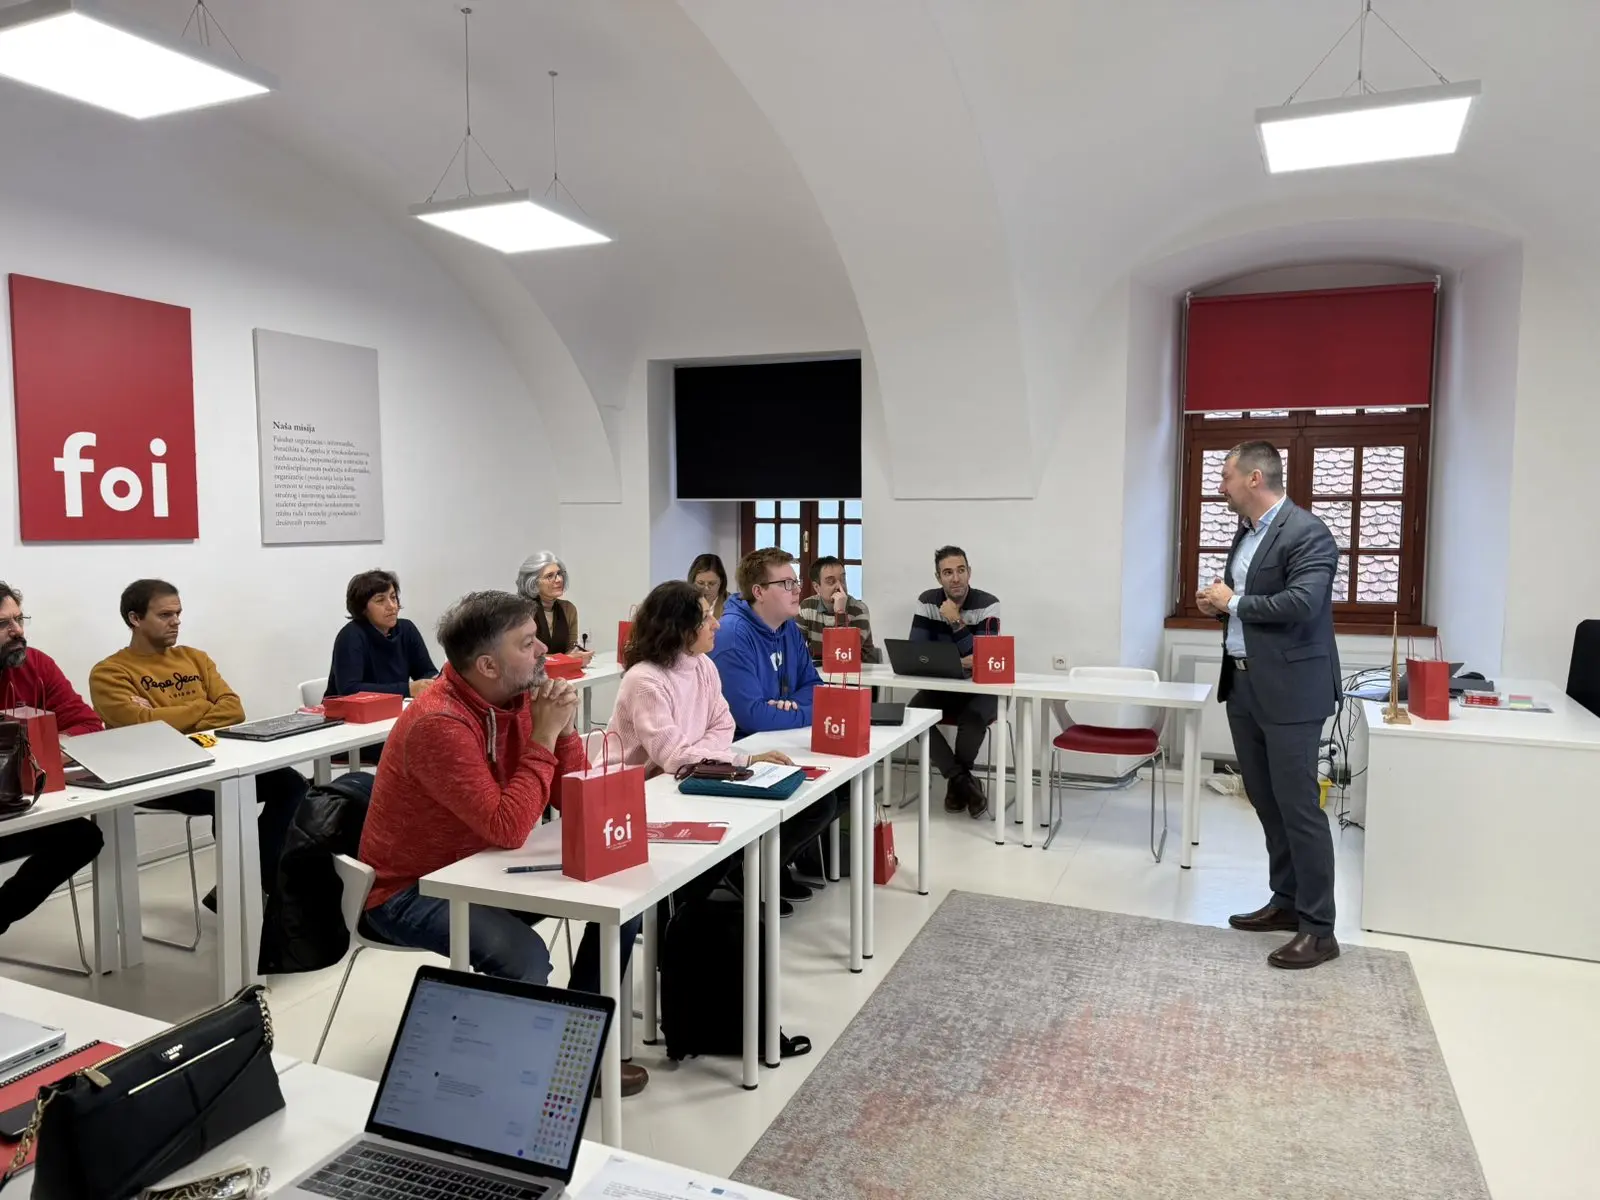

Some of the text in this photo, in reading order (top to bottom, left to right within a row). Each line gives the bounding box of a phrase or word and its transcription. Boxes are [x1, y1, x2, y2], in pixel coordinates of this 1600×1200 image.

[273, 421, 316, 433] Naša misija
[53, 431, 169, 518] foi
[835, 647, 852, 660] foi
[987, 657, 1005, 670] foi
[141, 675, 174, 693] Pepe
[823, 716, 846, 736] foi
[603, 813, 632, 847] foi
